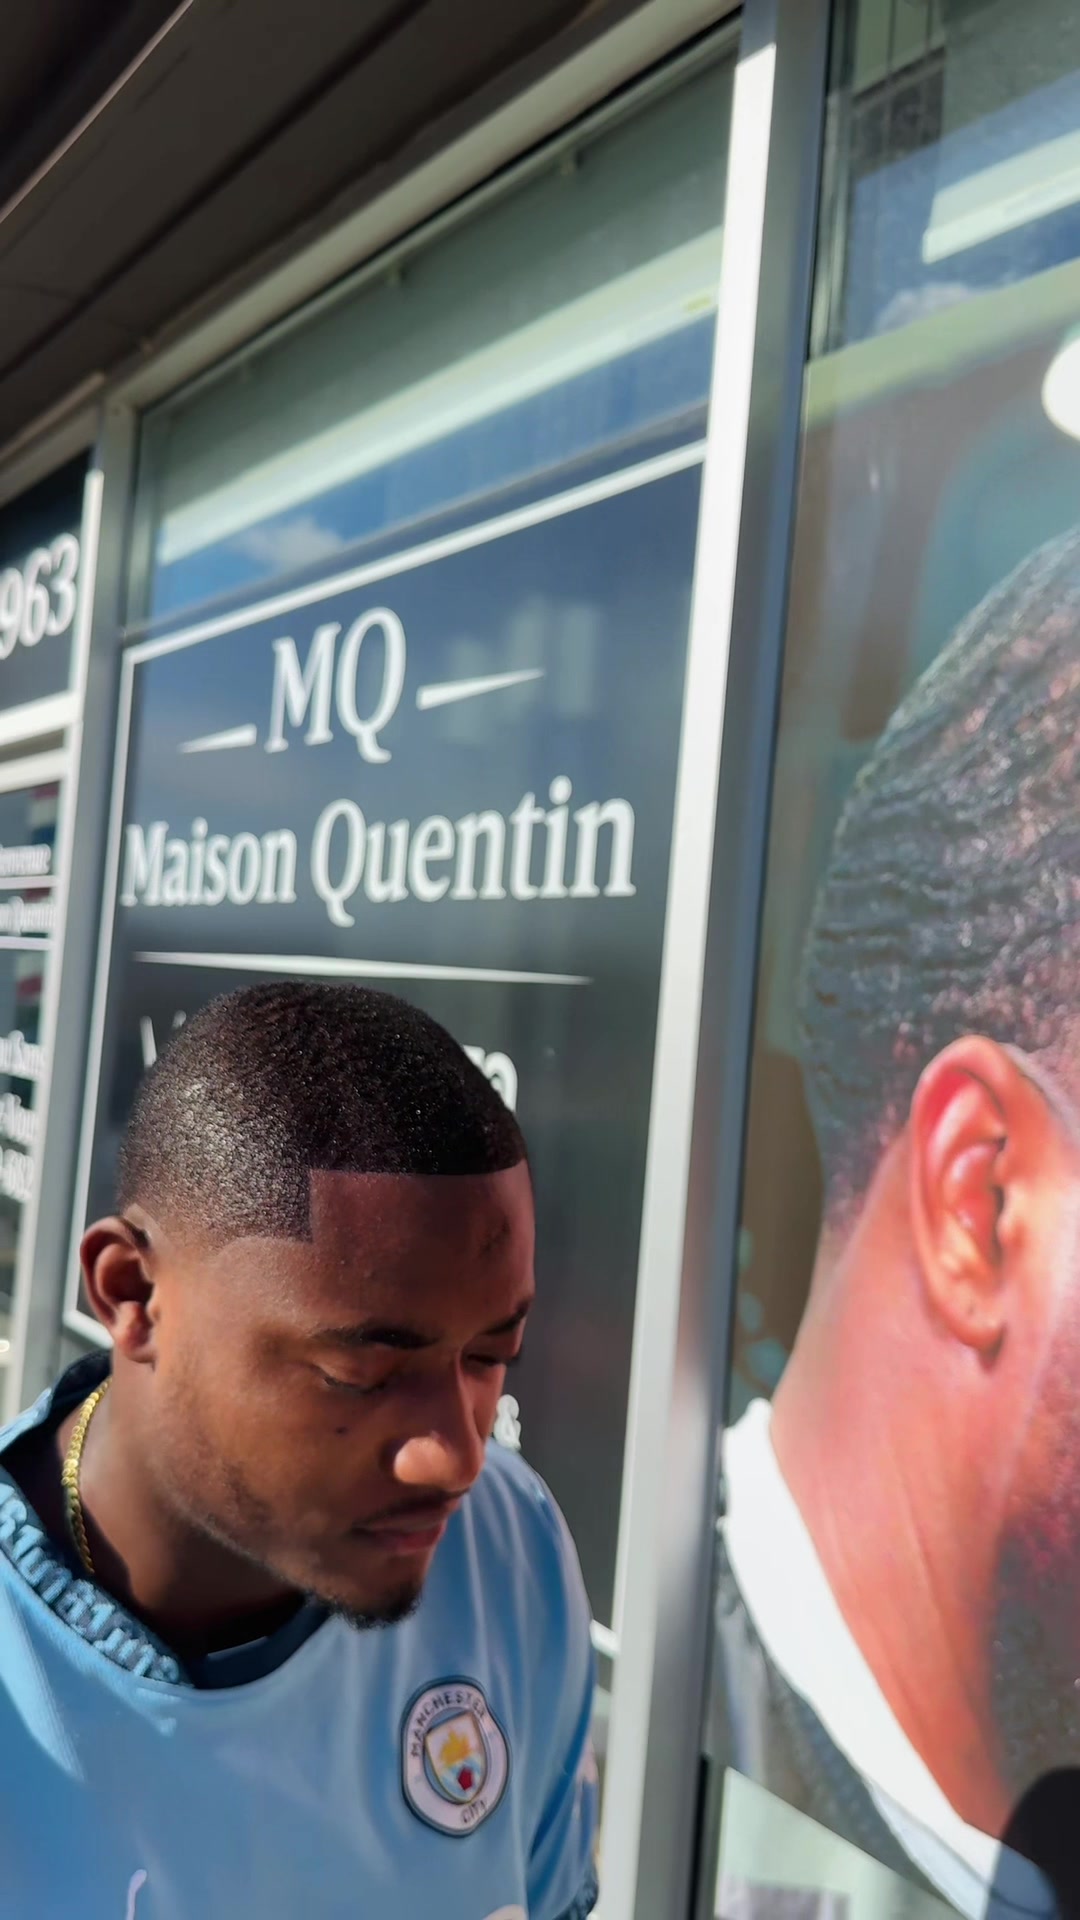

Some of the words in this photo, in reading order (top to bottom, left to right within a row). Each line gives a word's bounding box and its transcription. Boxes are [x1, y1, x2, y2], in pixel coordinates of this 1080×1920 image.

[264, 606, 407, 763] MQ
[121, 816, 298, 907] Maison
[310, 775, 637, 927] Quentin
